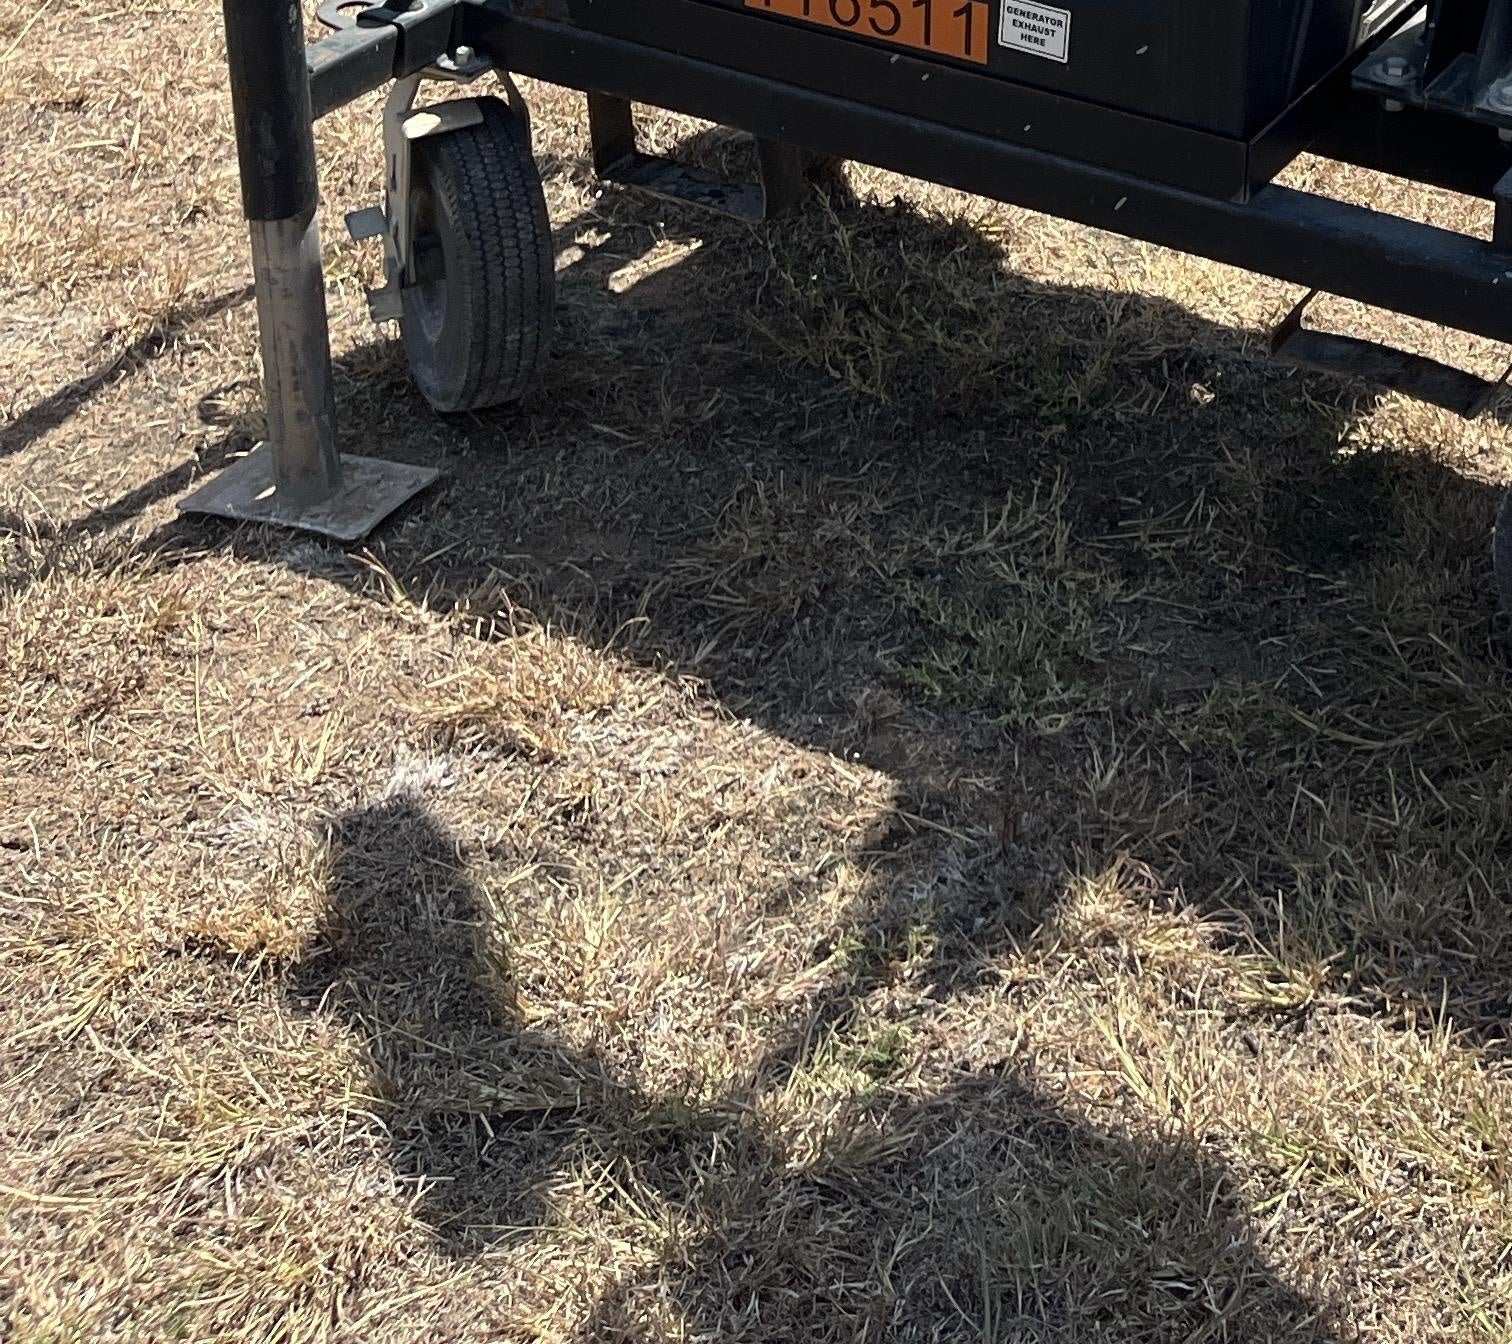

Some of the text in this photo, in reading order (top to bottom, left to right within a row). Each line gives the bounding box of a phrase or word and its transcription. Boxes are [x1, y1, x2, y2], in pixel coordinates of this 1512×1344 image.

[1006, 4, 1065, 29] GENERATOR
[1012, 17, 1057, 38] EXHAUST
[1021, 32, 1047, 47] HERE
